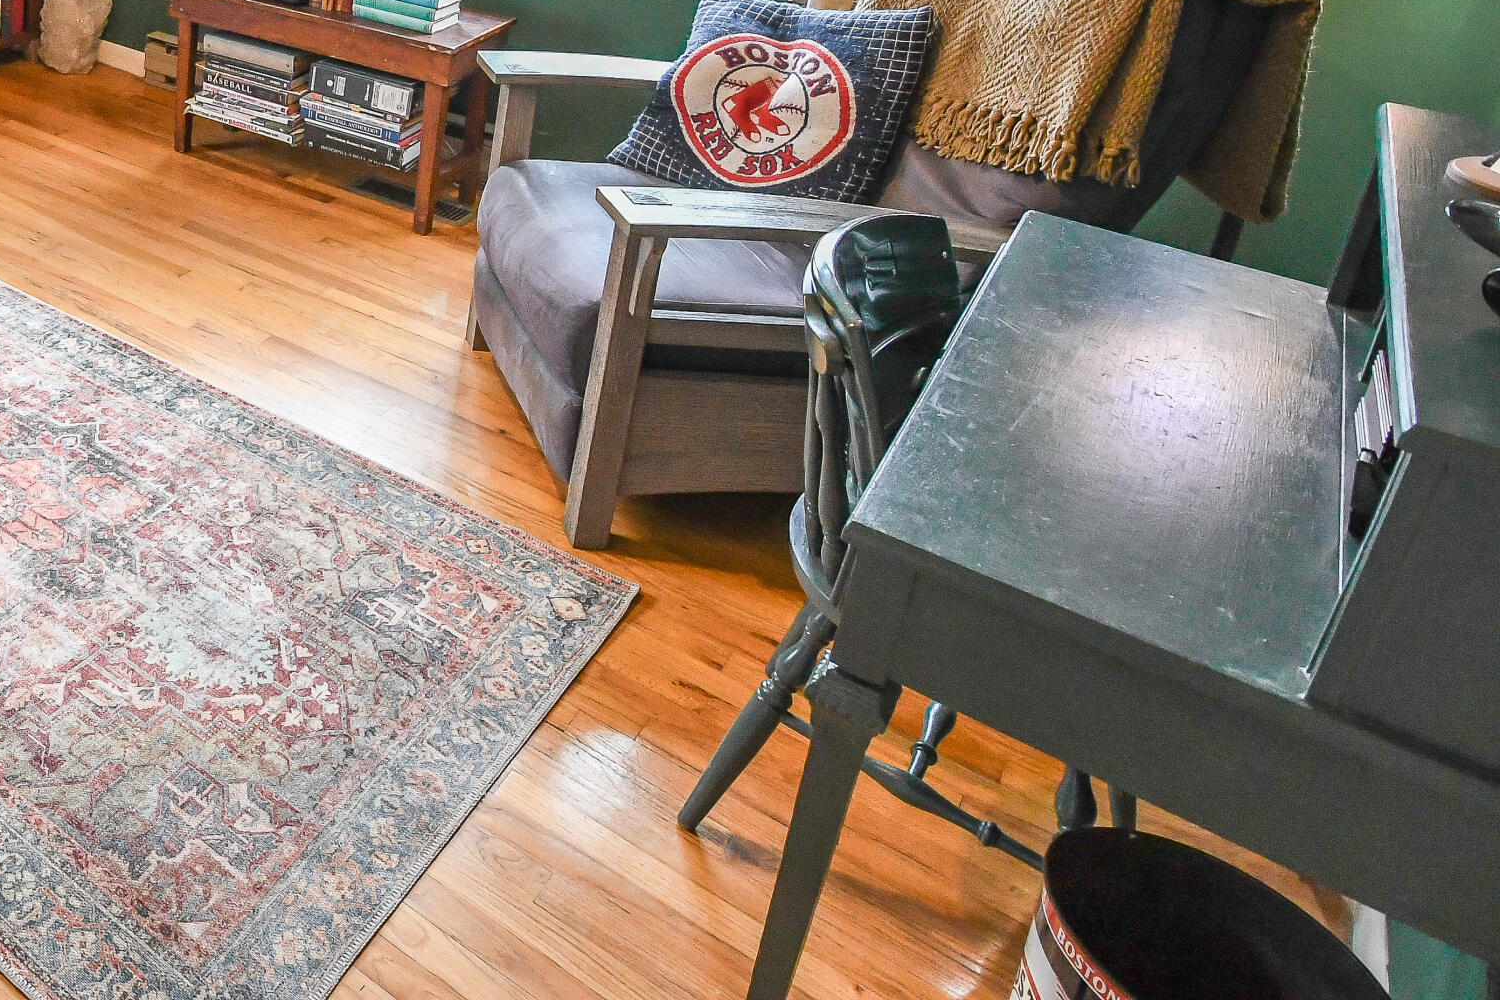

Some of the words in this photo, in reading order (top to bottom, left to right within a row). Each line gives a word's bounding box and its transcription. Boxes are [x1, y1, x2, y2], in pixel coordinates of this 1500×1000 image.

[207, 74, 252, 93] BASEBALL
[715, 42, 837, 98] BOSTON
[691, 111, 734, 161] RED
[738, 144, 804, 176] SOX
[1057, 926, 1121, 1000] BOSTON
